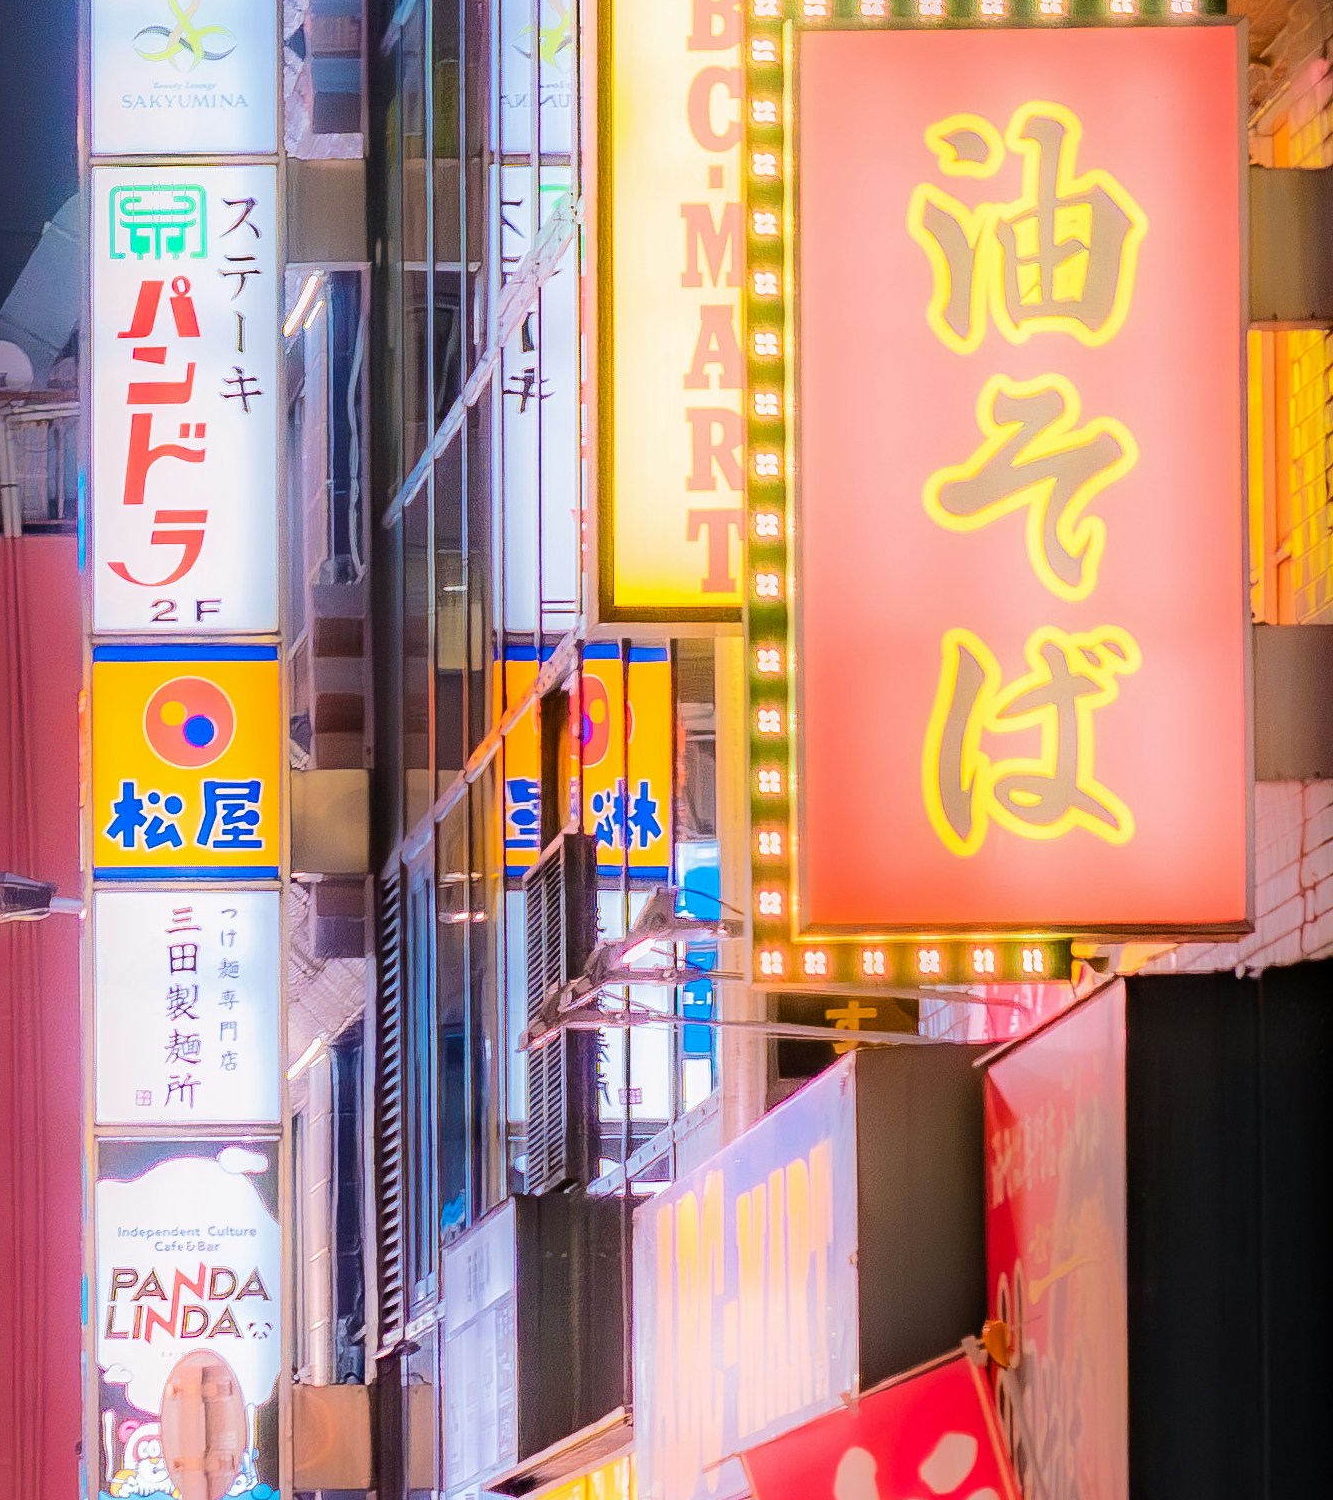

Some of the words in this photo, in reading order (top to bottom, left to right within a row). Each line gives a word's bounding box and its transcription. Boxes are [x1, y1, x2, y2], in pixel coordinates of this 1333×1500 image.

[120, 94, 250, 109] SAKYUMINA
[217, 195, 263, 414] ステーキ
[107, 276, 209, 587] パンドラ
[908, 100, 1148, 857] 油そば
[149, 598, 222, 623] 2F
[103, 779, 264, 851] 松屋
[164, 907, 203, 1109] 三田製麺所
[219, 908, 241, 1072] つけ麺専門店
[117, 1226, 201, 1240] Independent
[207, 1225, 257, 1238] Culture
[108, 1264, 272, 1303] PANDA
[103, 1300, 246, 1344] LINDA
